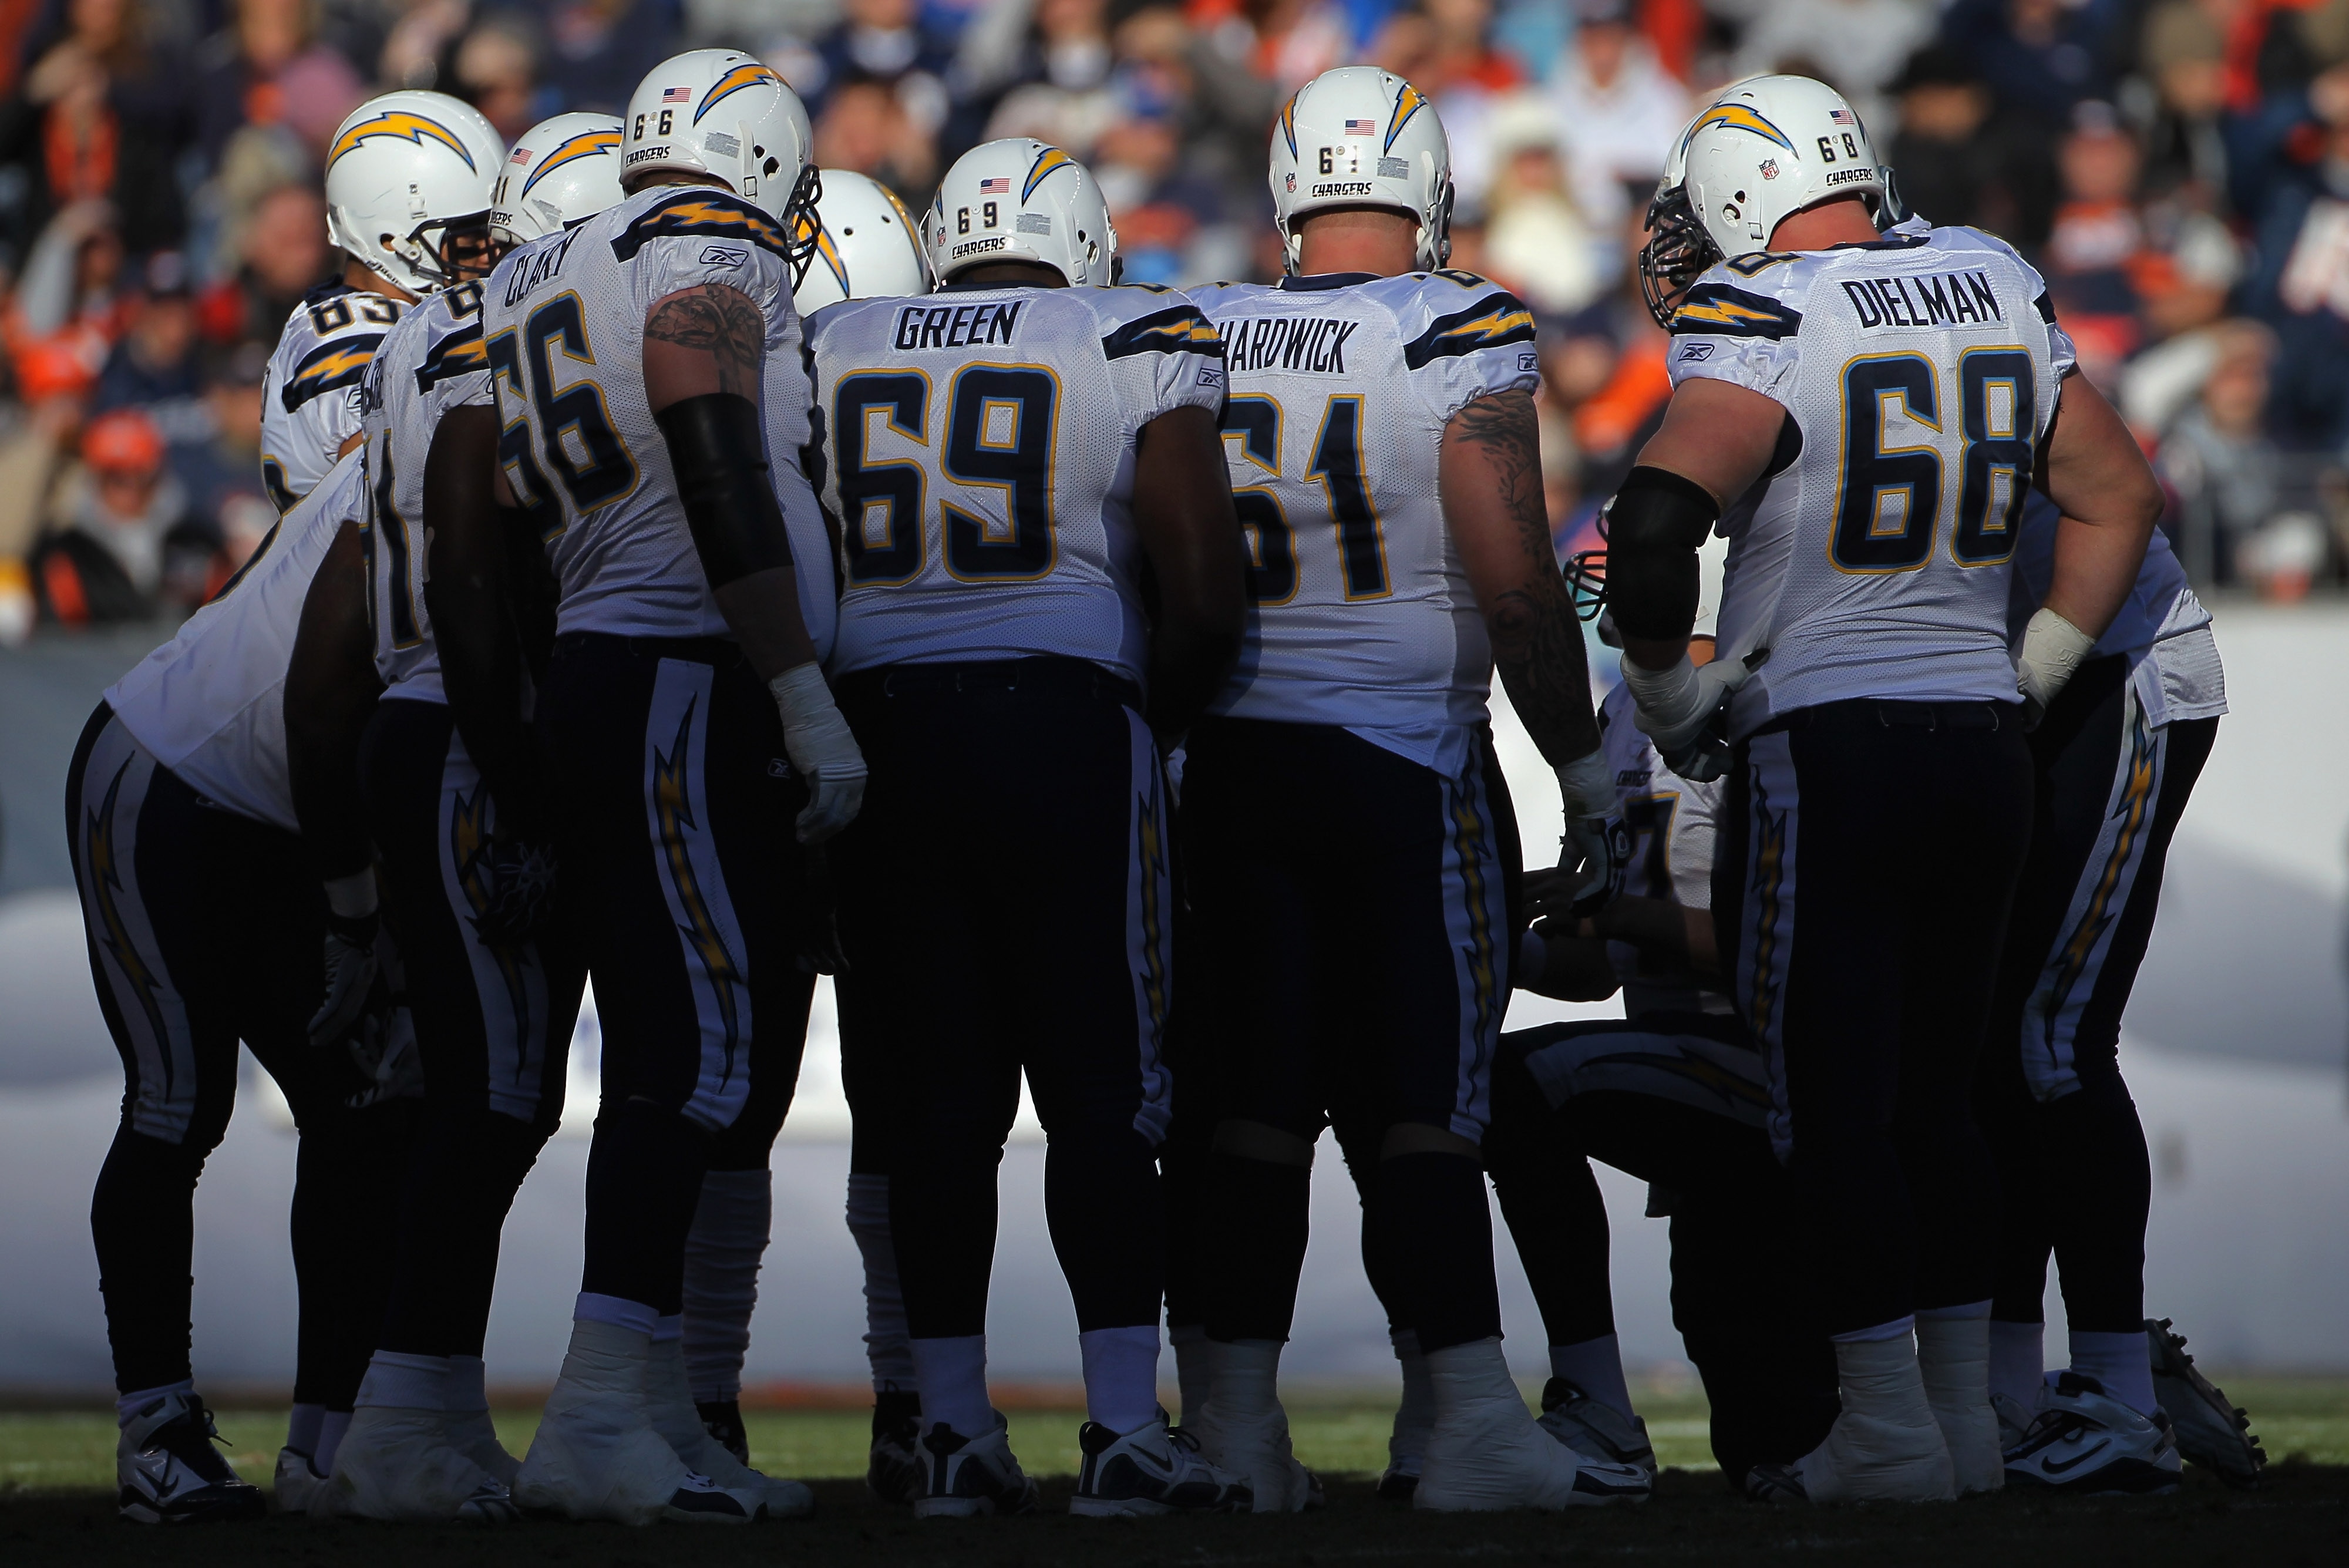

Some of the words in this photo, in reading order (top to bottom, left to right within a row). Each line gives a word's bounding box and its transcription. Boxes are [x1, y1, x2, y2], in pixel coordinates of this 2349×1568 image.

[1312, 181, 1372, 197] CHARGERS
[1826, 168, 1873, 186] CHARGERS
[958, 201, 997, 235] 69
[952, 236, 1007, 260] CHARGERS
[894, 301, 1022, 349] GREEN
[1841, 272, 2001, 328] DIELMAN
[1217, 318, 1359, 374] HARDWICK
[486, 289, 641, 544] 66
[832, 360, 1062, 588] 69
[1827, 345, 2038, 575] 68
[1220, 393, 1393, 607] 61
